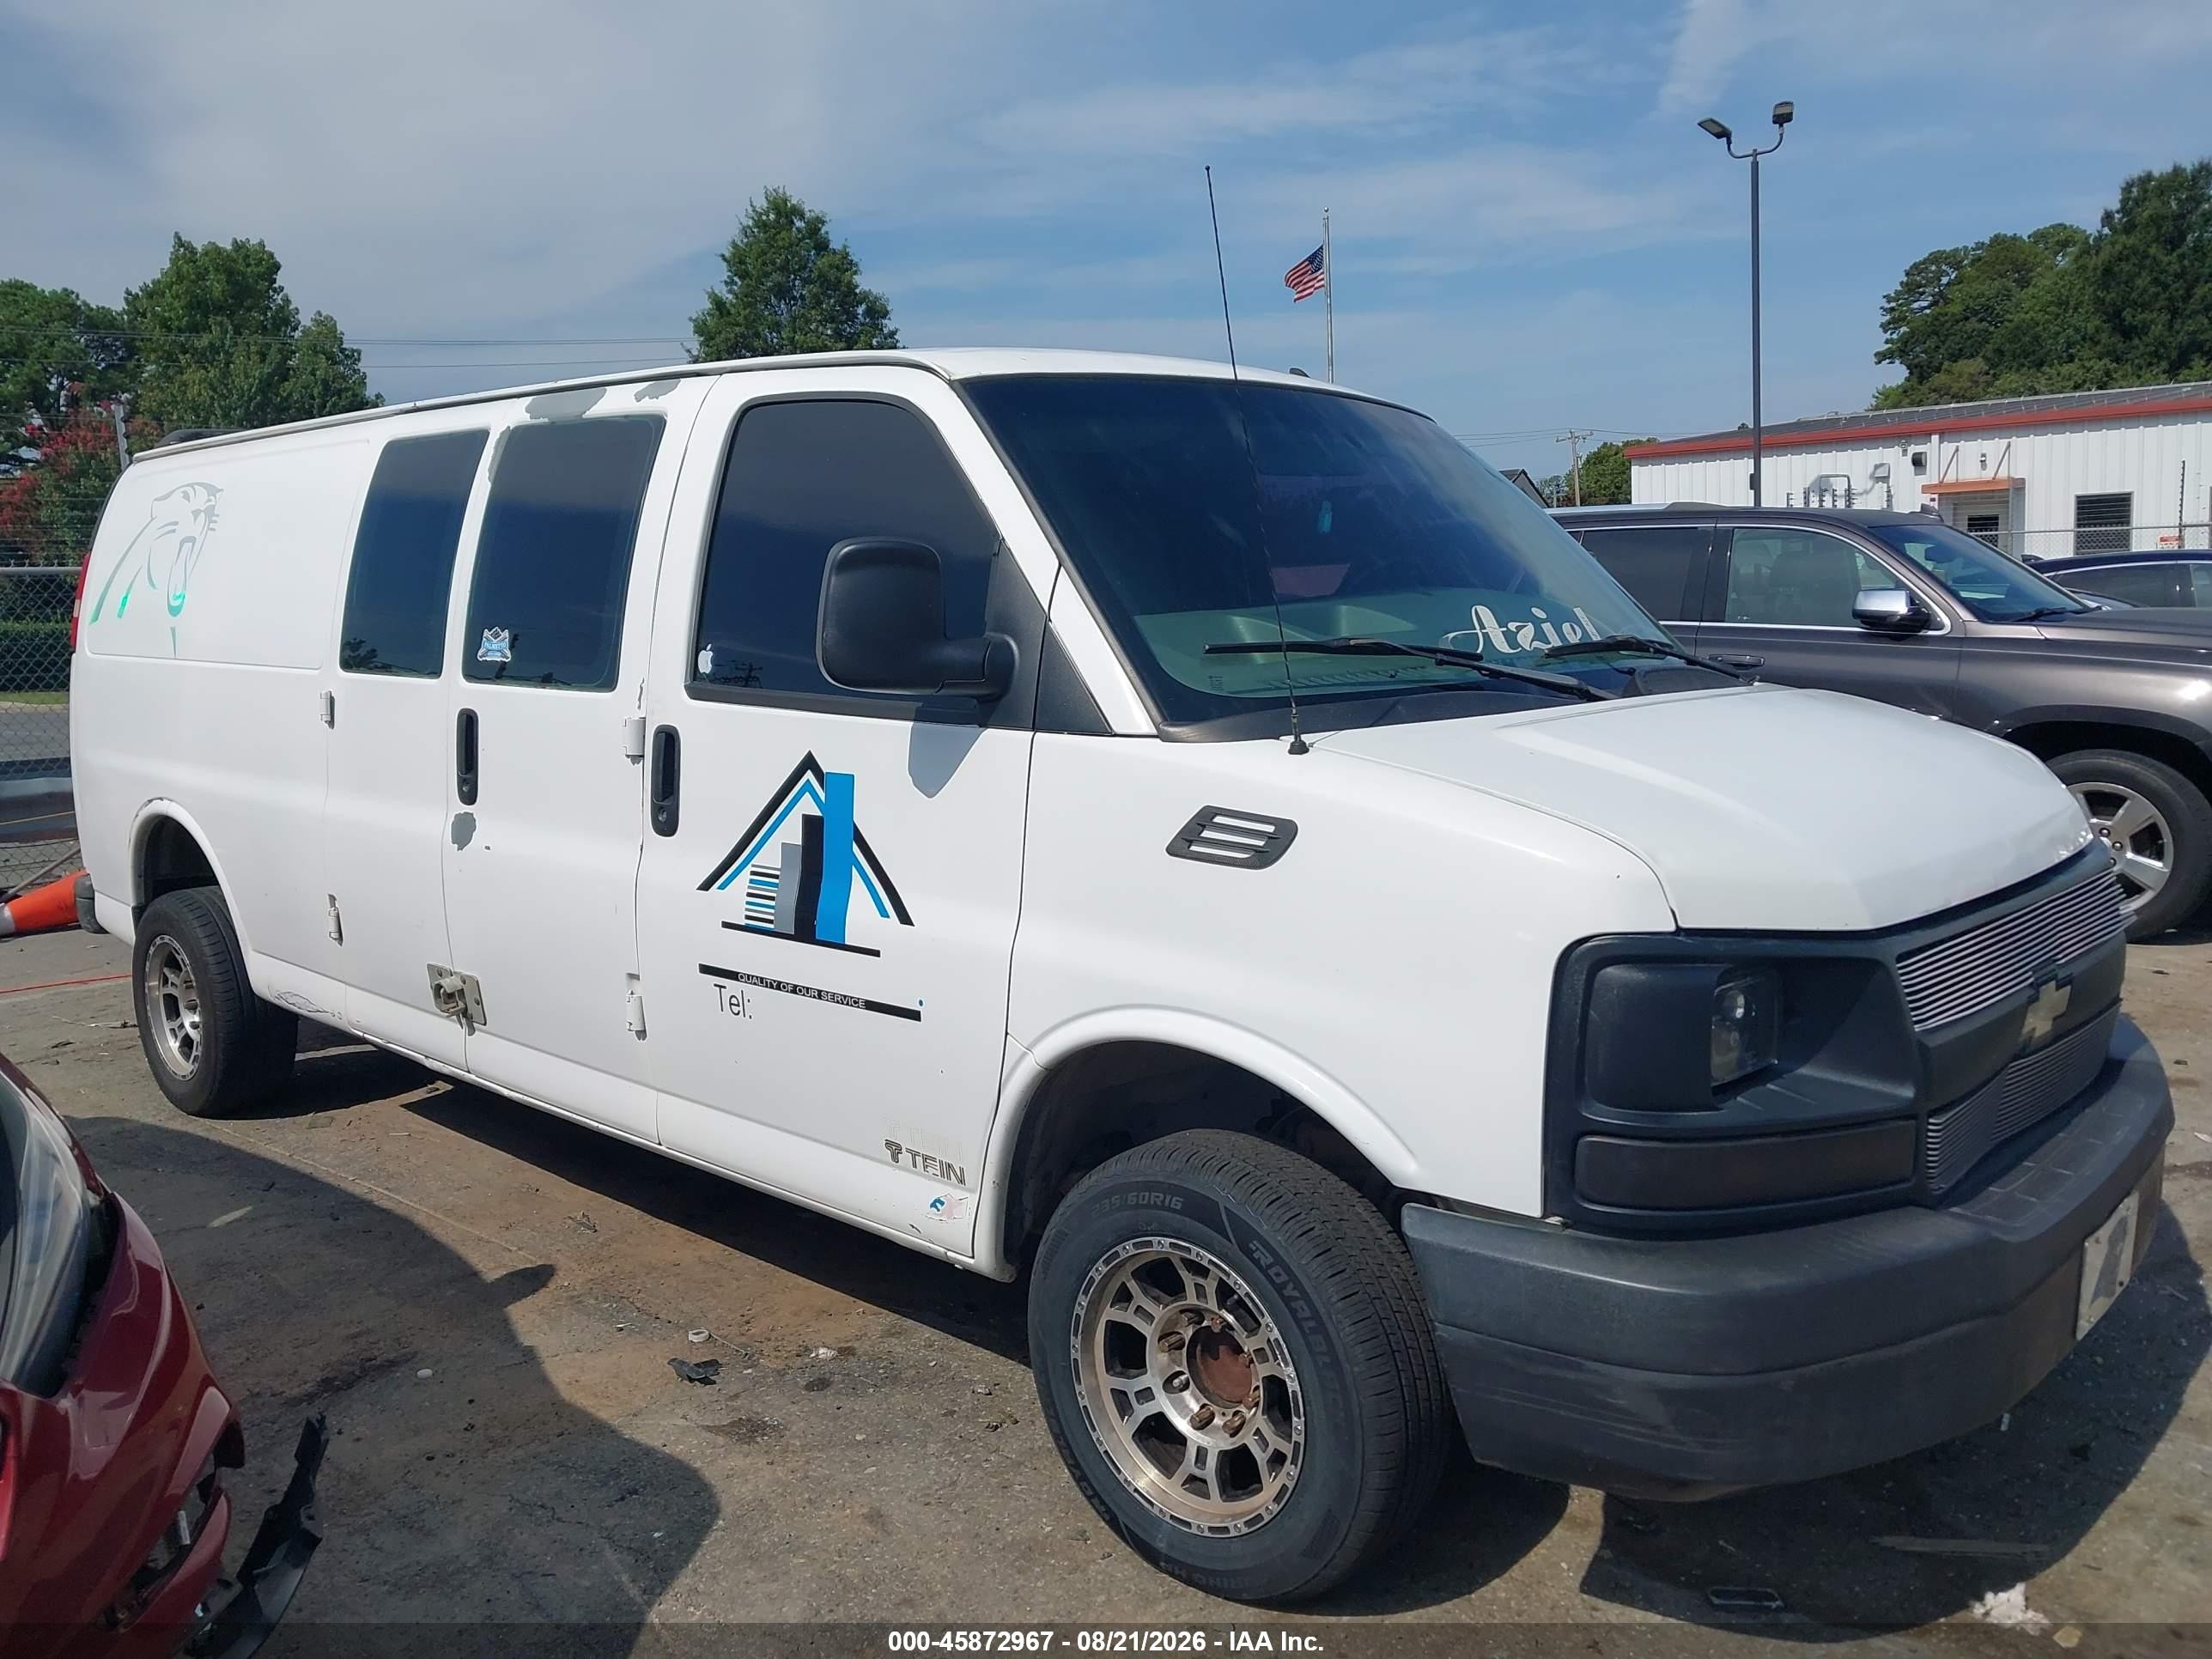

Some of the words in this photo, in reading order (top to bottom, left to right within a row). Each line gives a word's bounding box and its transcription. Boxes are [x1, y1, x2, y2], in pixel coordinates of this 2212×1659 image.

[1438, 605, 1601, 653] Aziel
[714, 983, 752, 1019] Tel:
[738, 973, 778, 988] QUALITY
[780, 982, 793, 993] OF
[796, 987, 819, 999] OUR
[821, 992, 866, 1008] SERVICE
[905, 1147, 966, 1186] TEIN
